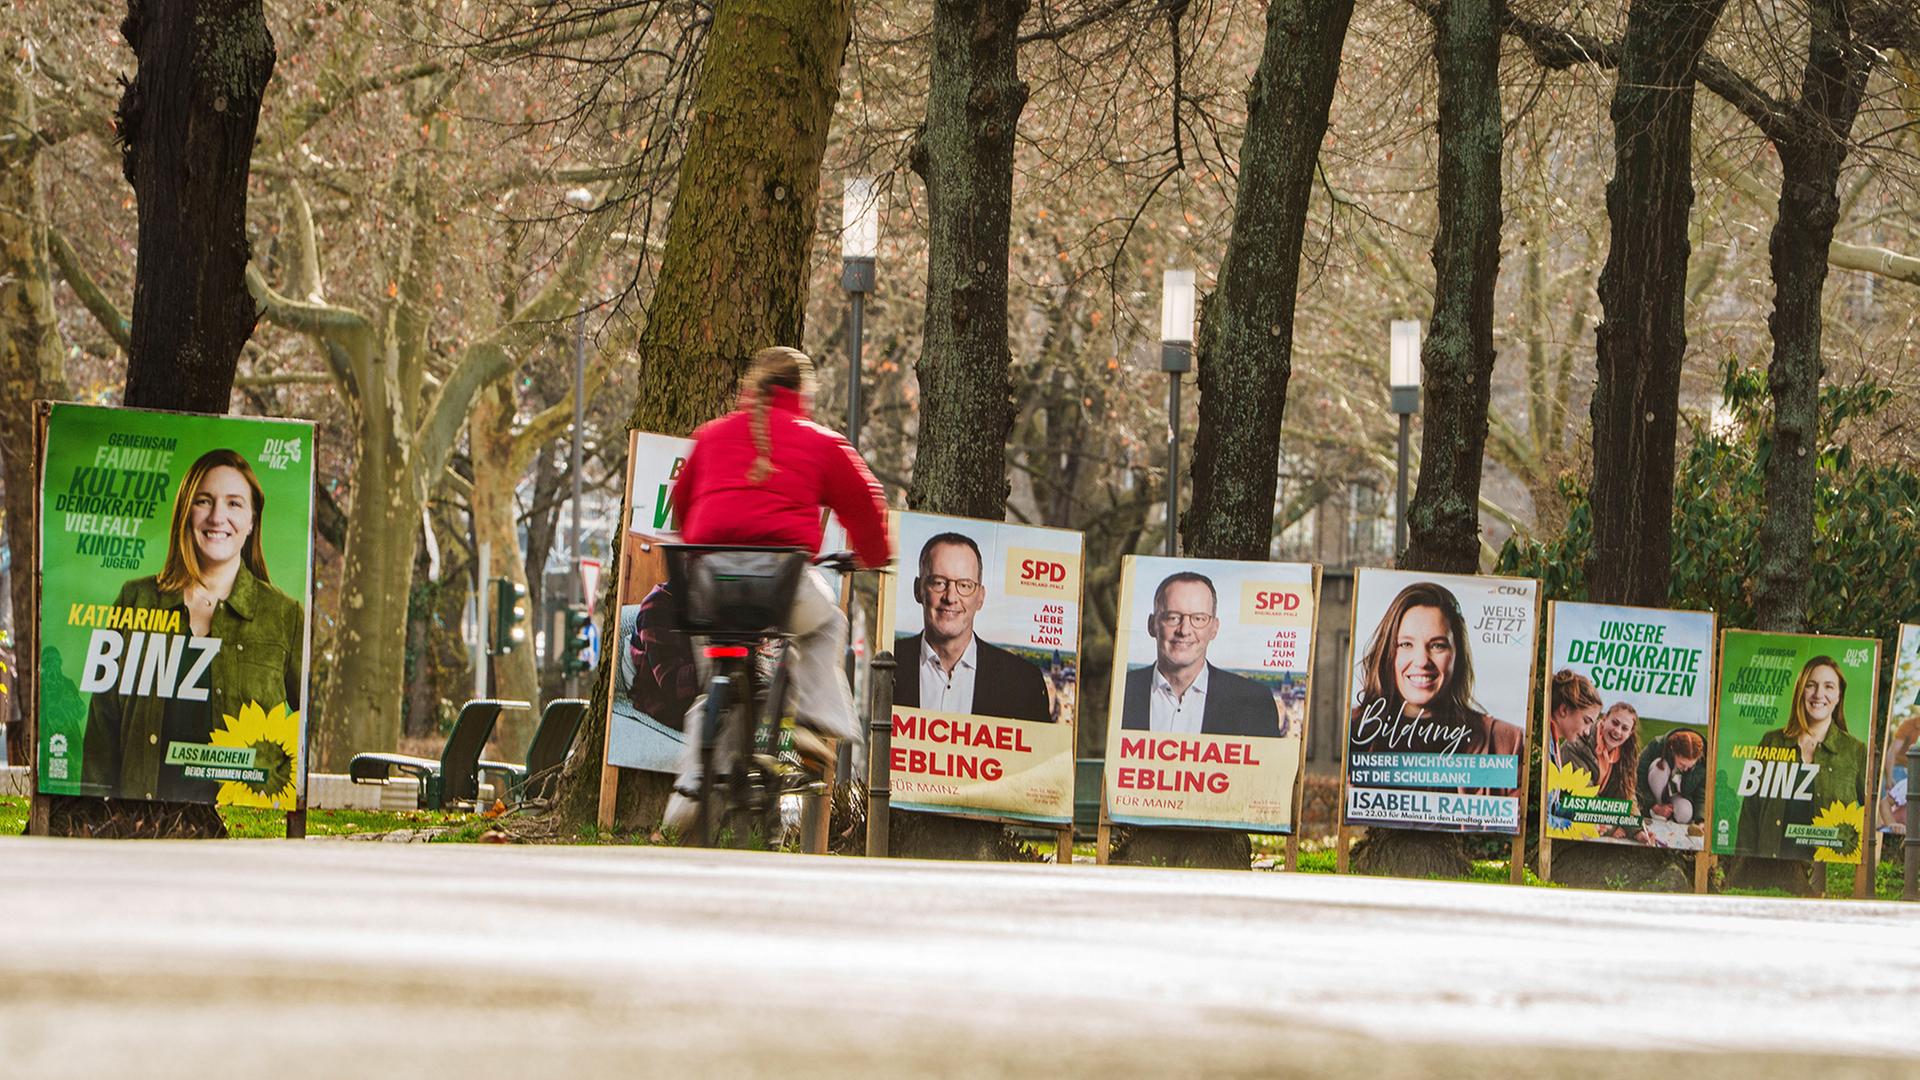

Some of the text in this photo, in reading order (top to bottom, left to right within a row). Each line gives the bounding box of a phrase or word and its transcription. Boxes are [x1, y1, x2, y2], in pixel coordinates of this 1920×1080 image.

[108, 433, 178, 451] GEMEINSAM
[263, 438, 284, 454] DU
[94, 445, 175, 473] FAMILIE
[269, 455, 289, 470] MZ
[69, 466, 170, 502] KULTUR
[56, 495, 158, 519] DEMOKRATIE
[65, 512, 143, 537] VIELFALT
[76, 535, 146, 559] KINDER
[100, 557, 140, 570] JUGEND
[1021, 559, 1066, 582] SPD
[1498, 586, 1527, 596] CDU
[1255, 591, 1300, 611] SPD
[1042, 604, 1064, 615] AUS
[1483, 605, 1526, 618] WEIL'S
[68, 603, 181, 633] KATHARINA
[1033, 614, 1063, 625] LIEBE
[1474, 617, 1526, 632] JETZT
[1039, 625, 1063, 635] ZUM
[1276, 631, 1297, 639] AUS
[1600, 621, 1666, 644] UNSERE
[1030, 635, 1062, 646] LAND.
[1267, 640, 1296, 648] LIEBE
[1482, 632, 1511, 645] GILT
[1272, 650, 1295, 658] ZUM
[1567, 639, 1702, 673] DEMOKRATIE
[1750, 655, 1794, 669] FAMILIE
[80, 628, 222, 701] BINZ
[1263, 659, 1295, 668] LAND.
[1591, 666, 1697, 697] SCHÜTZEN
[1737, 667, 1792, 686] KULTUR
[1728, 682, 1784, 696] DEMOKRATIE
[1733, 693, 1776, 707] VIELFALT
[1739, 705, 1778, 719] KINDER
[1351, 690, 1472, 760] Bildung.
[892, 714, 1032, 753] MICHAEL
[171, 747, 250, 765] LASS MACHEN!
[1120, 737, 1260, 765] MICHAEL
[1732, 745, 1796, 762] KATHARINA
[890, 747, 1003, 782] EBLING
[1352, 755, 1513, 769] UNSERE WICHTIGSTE BANK
[184, 766, 265, 782] BEIDE STIMMEN GRÜN.
[1117, 767, 1230, 794] EBLING
[1352, 771, 1471, 784] IST DIE SCHULBANK!
[1737, 760, 1820, 800] BINZ
[890, 778, 960, 795] FÜR MAINZ
[1116, 795, 1184, 810] FÜR MAINZ
[1353, 792, 1513, 817] ISABELL RAHMS
[1562, 797, 1629, 813] LASS MACHEN!
[1401, 812, 1423, 820] Mainz
[1437, 814, 1450, 822] den
[1452, 816, 1482, 825] Landtag
[1573, 812, 1640, 826] ZWEITSTIMME GRÜN.
[1788, 826, 1806, 835] LASS
